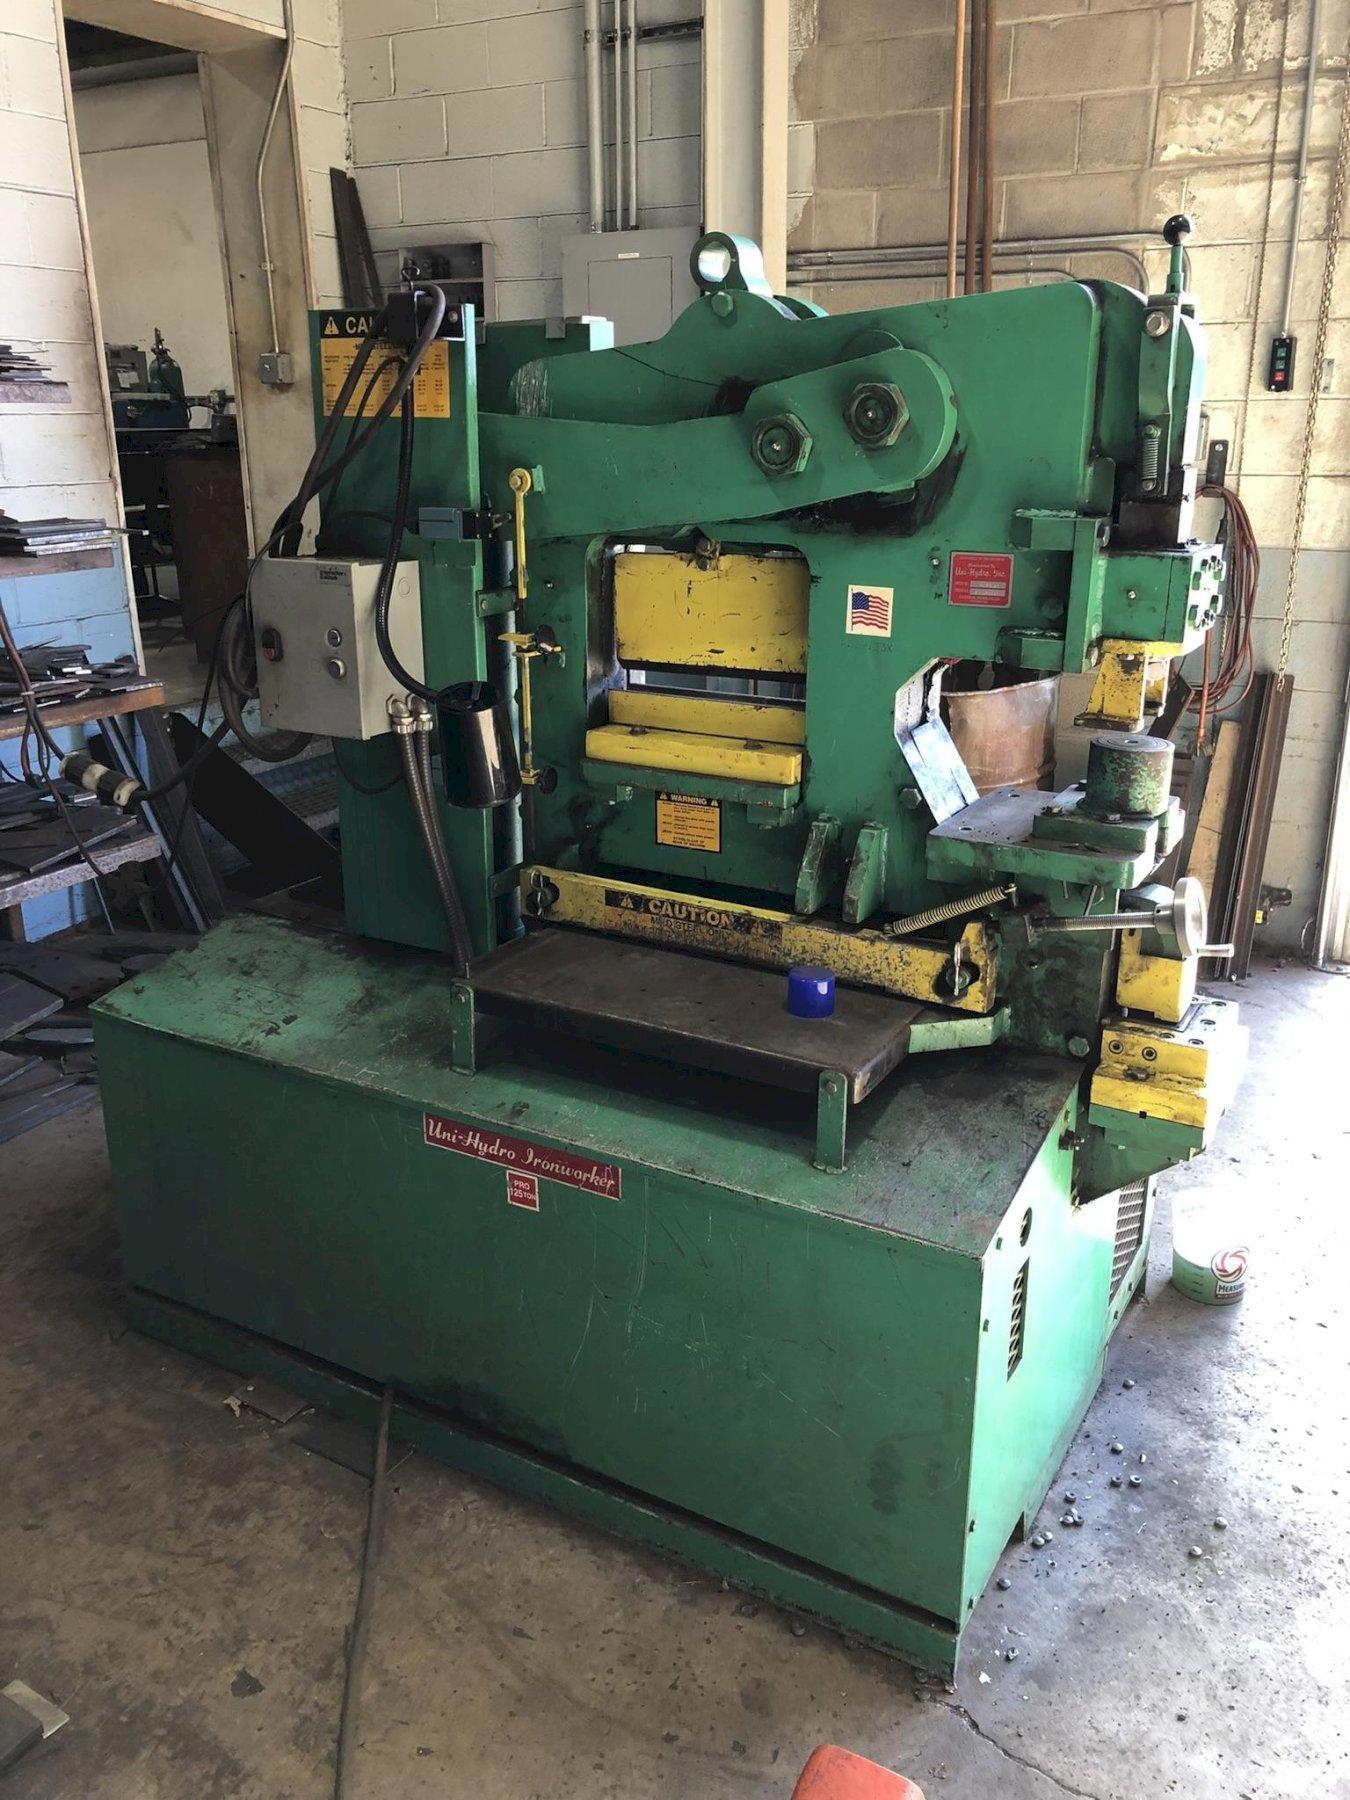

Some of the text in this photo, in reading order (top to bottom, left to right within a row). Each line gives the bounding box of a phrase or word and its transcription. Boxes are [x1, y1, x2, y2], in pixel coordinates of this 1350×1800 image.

[670, 793, 707, 806] WARNING
[428, 1118, 615, 1191] Uni-Hydro Ironworker
[514, 1179, 530, 1190] PRO
[510, 1187, 524, 1198] 125
